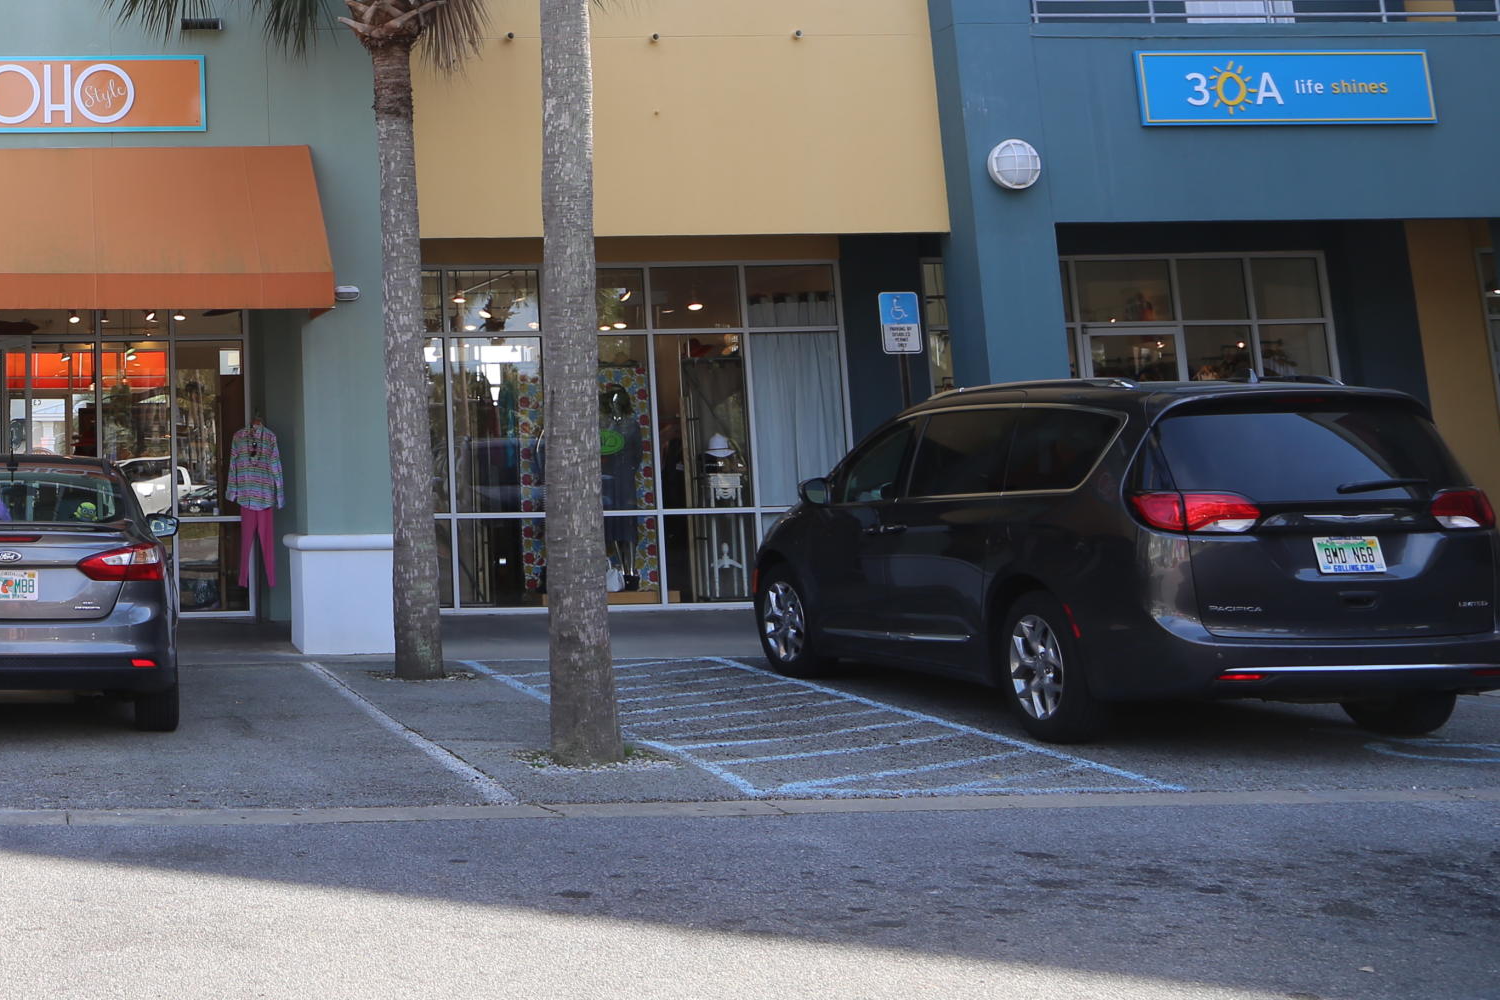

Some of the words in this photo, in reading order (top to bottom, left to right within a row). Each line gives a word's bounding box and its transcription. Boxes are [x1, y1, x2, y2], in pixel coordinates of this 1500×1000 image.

[84, 79, 127, 109] Style
[1295, 79, 1324, 94] life
[1331, 79, 1389, 94] shines
[1208, 604, 1263, 612] PACIFICA
